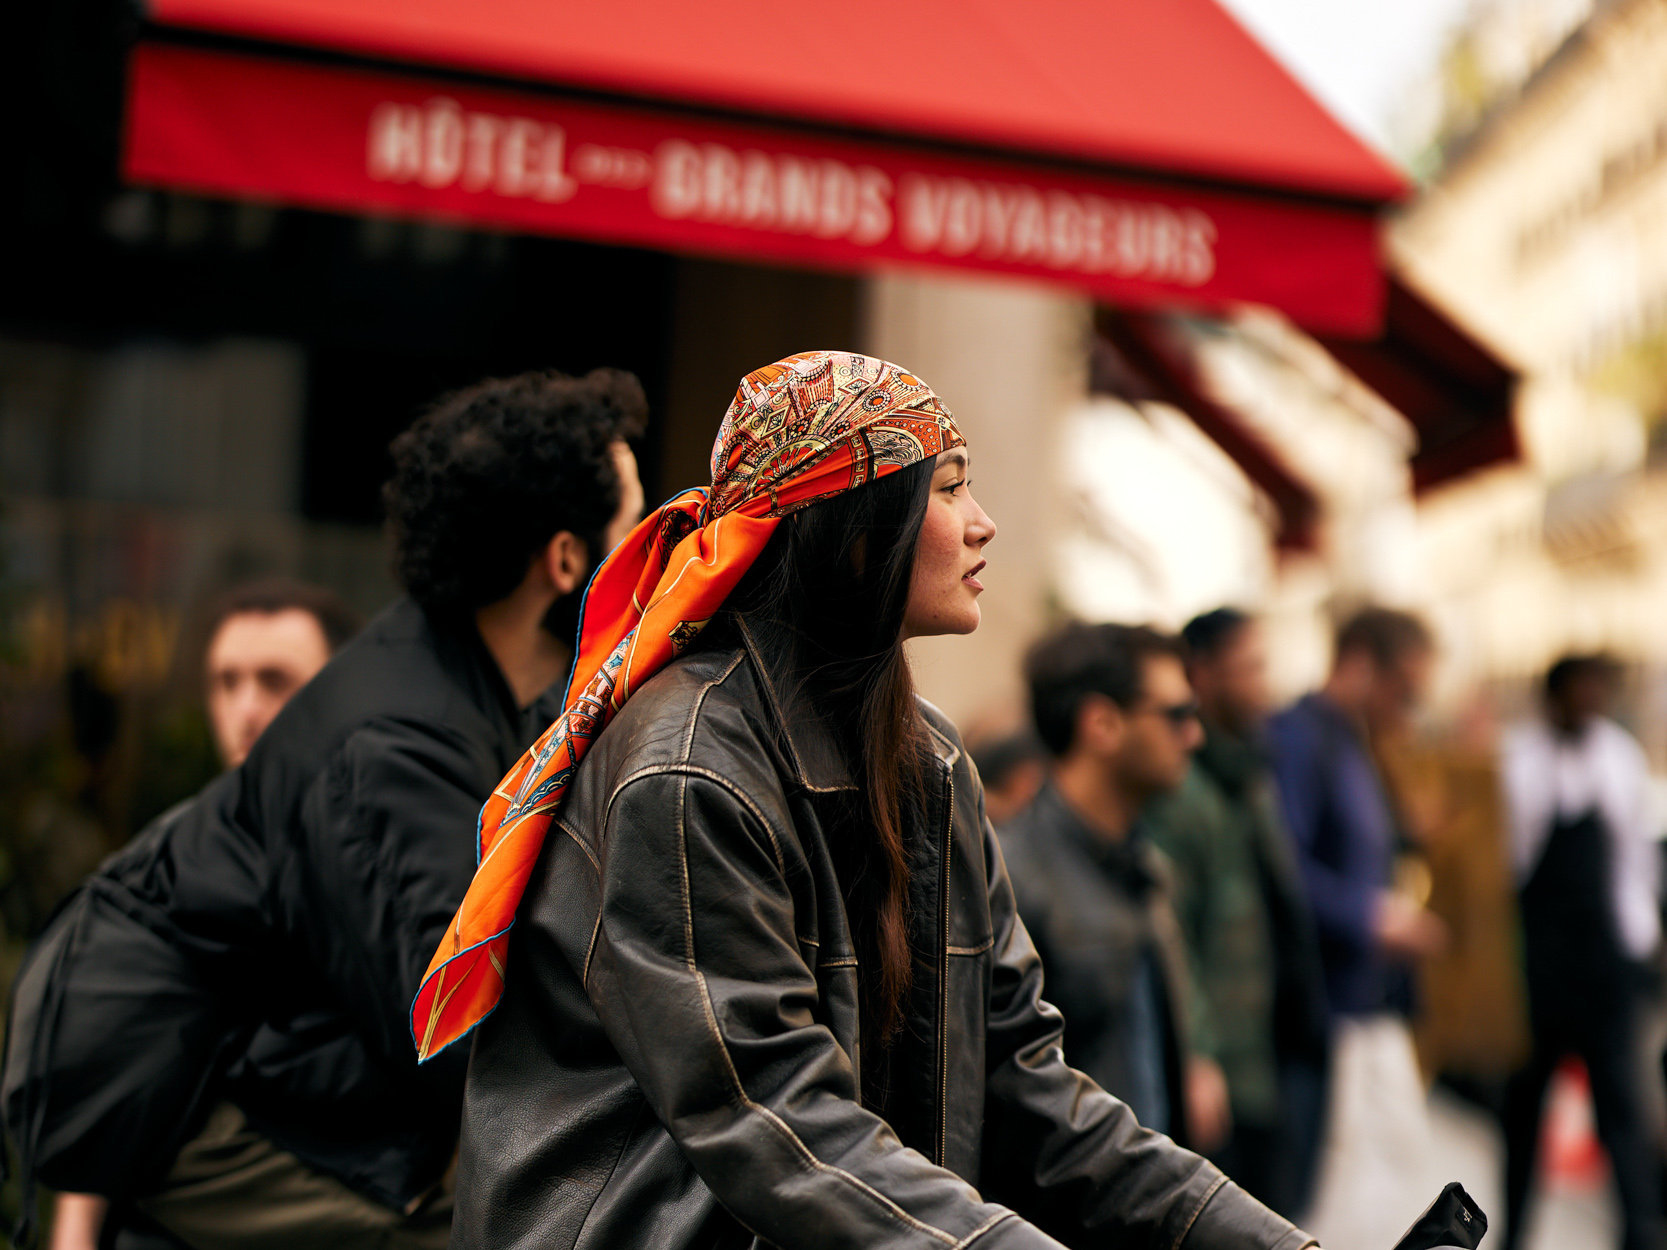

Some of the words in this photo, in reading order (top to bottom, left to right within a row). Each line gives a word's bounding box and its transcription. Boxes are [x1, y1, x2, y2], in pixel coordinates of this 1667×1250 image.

[370, 98, 577, 203] HÔTEL
[653, 140, 893, 246] GRANDS
[902, 174, 1216, 286] VOYAGEURS
